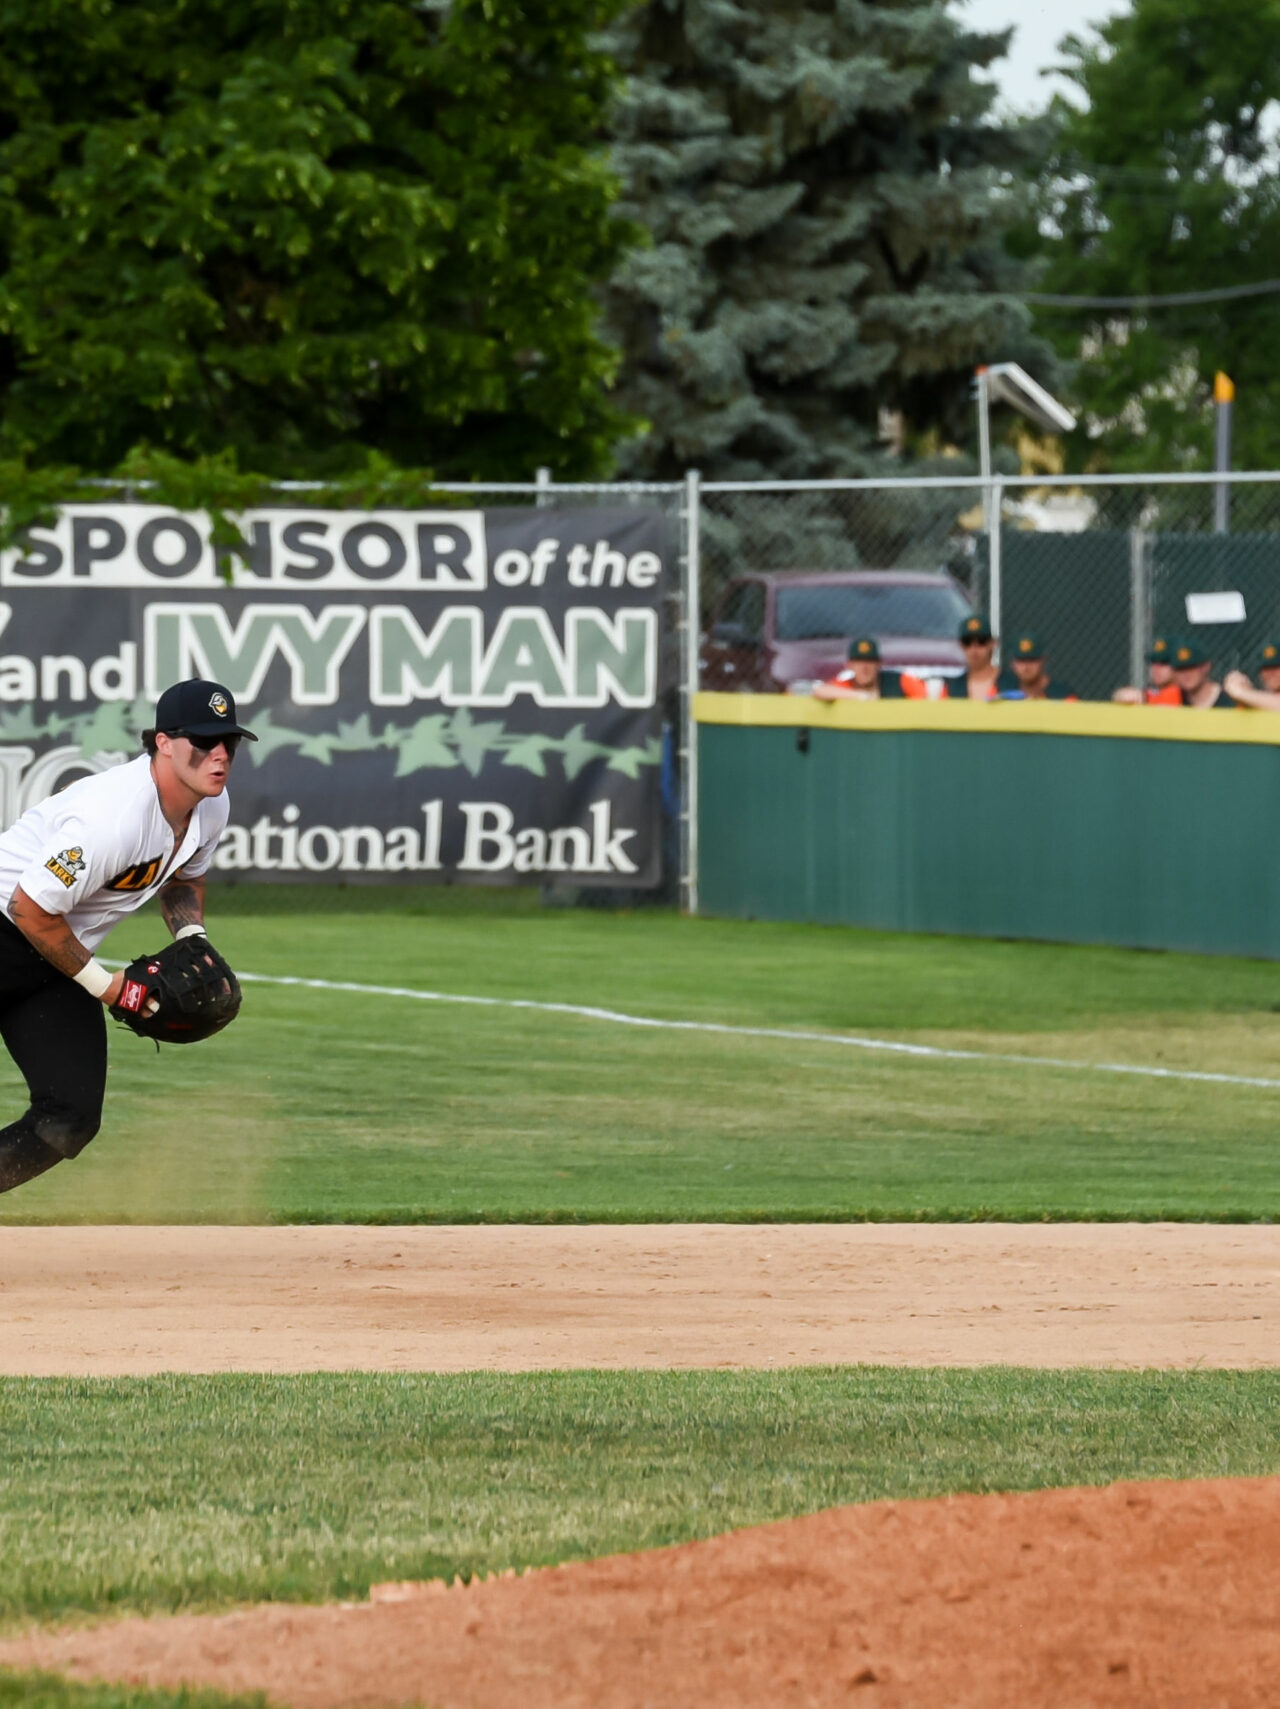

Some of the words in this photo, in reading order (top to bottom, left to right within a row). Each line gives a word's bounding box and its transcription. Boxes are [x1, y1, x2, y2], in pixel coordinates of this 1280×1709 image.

[10, 514, 474, 581] SPONSOR
[493, 539, 559, 587] of
[567, 541, 662, 588] the
[143, 604, 368, 706] IVY
[368, 605, 658, 708] MAN
[45, 857, 76, 888] LARKS
[208, 799, 444, 873] ational
[458, 801, 638, 874] Bank
